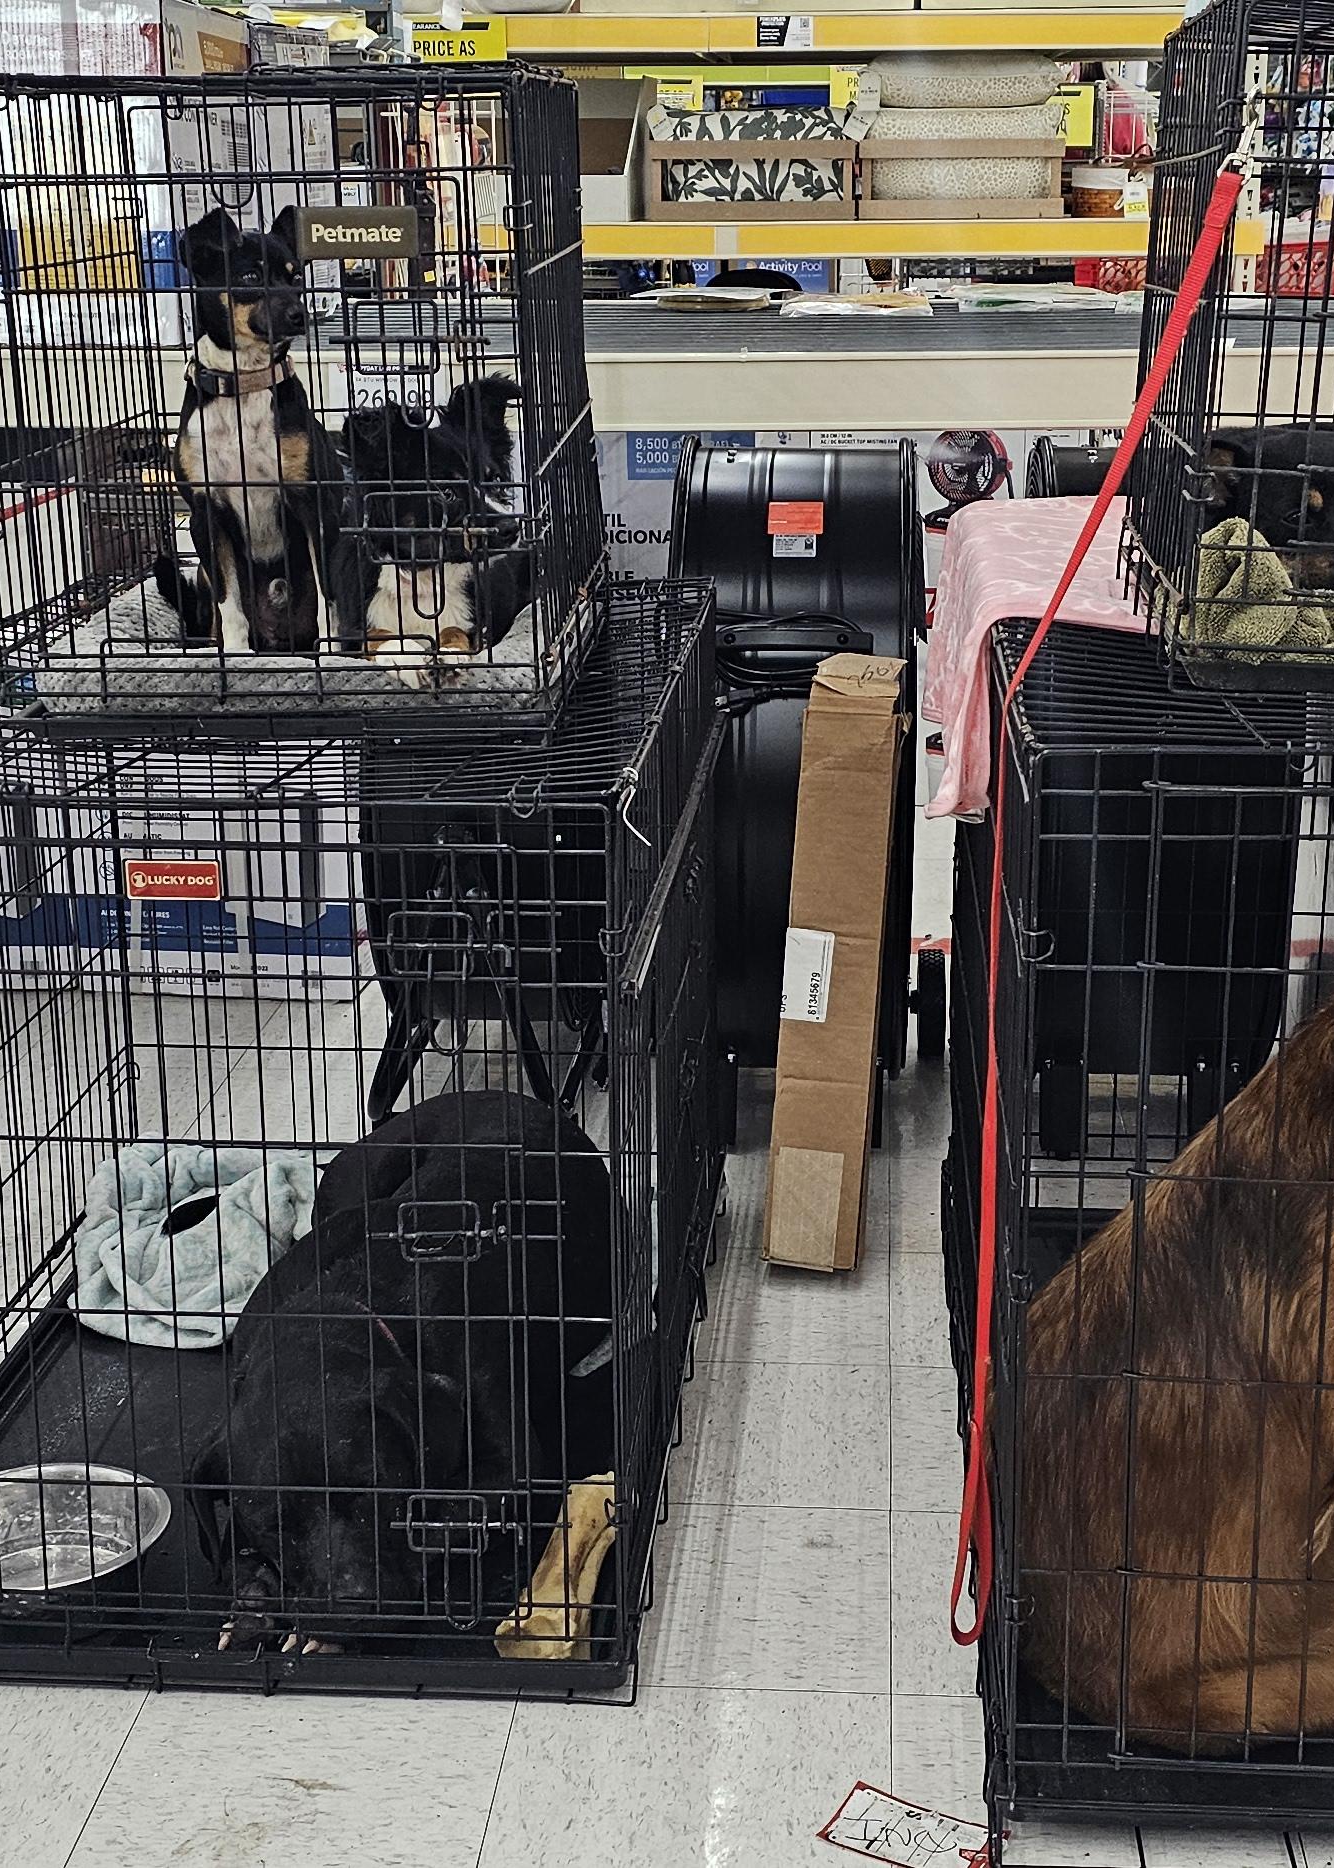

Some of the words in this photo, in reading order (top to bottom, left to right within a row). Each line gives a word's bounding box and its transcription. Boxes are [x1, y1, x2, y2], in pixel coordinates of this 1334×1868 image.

[414, 40, 454, 56] PRICE
[460, 40, 475, 56] AS
[311, 224, 402, 243] Petmate
[759, 260, 798, 273] Activity
[801, 261, 822, 271] Pool
[636, 438, 669, 450] 8,500
[636, 451, 669, 463] 5,000
[148, 875, 185, 885] LUCKY
[187, 876, 214, 885] DOG
